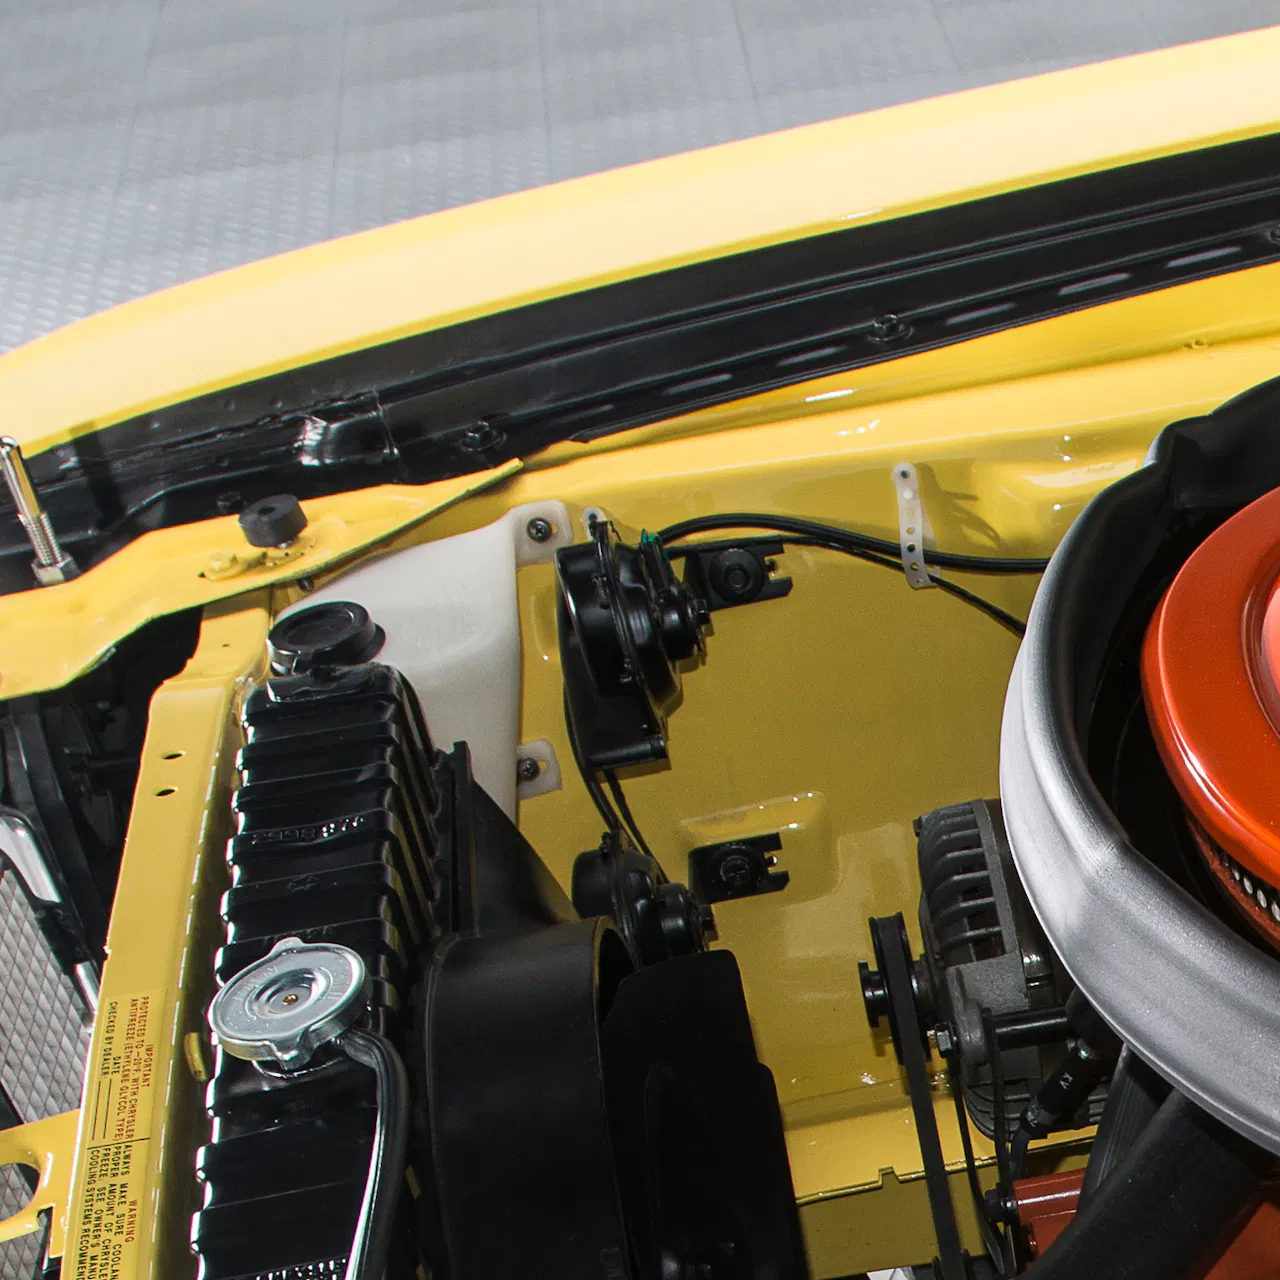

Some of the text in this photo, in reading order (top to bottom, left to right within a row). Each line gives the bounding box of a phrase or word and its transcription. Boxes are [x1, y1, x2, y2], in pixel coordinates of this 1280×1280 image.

[105, 1000, 118, 1033] CHECKED
[135, 995, 149, 1037] PROTECTED
[104, 1035, 113, 1045] BY
[135, 1039, 144, 1049] TO
[110, 1055, 121, 1075] DATE
[111, 998, 138, 1141] ANTIFREEZE (ETHYLENE GLYCOL TYPE)
[140, 1043, 154, 1088] IMPORTANT
[129, 1077, 139, 1096] WITH
[124, 1098, 137, 1139] CHRYSLER
[86, 1148, 100, 1184] COOLING
[97, 1147, 111, 1181] FREEZE.
[109, 1145, 121, 1178] PROPER
[120, 1143, 132, 1176] ALWAYS
[81, 1187, 95, 1225] SYSTEMS
[95, 1186, 106, 1203] SEE
[104, 1182, 117, 1217] AMOUNT
[116, 1182, 128, 1206] MAKE
[89, 1208, 104, 1248] OWNER'S
[102, 1221, 113, 1233] OF
[113, 1212, 125, 1236] SURE
[124, 1199, 137, 1243] WARNING
